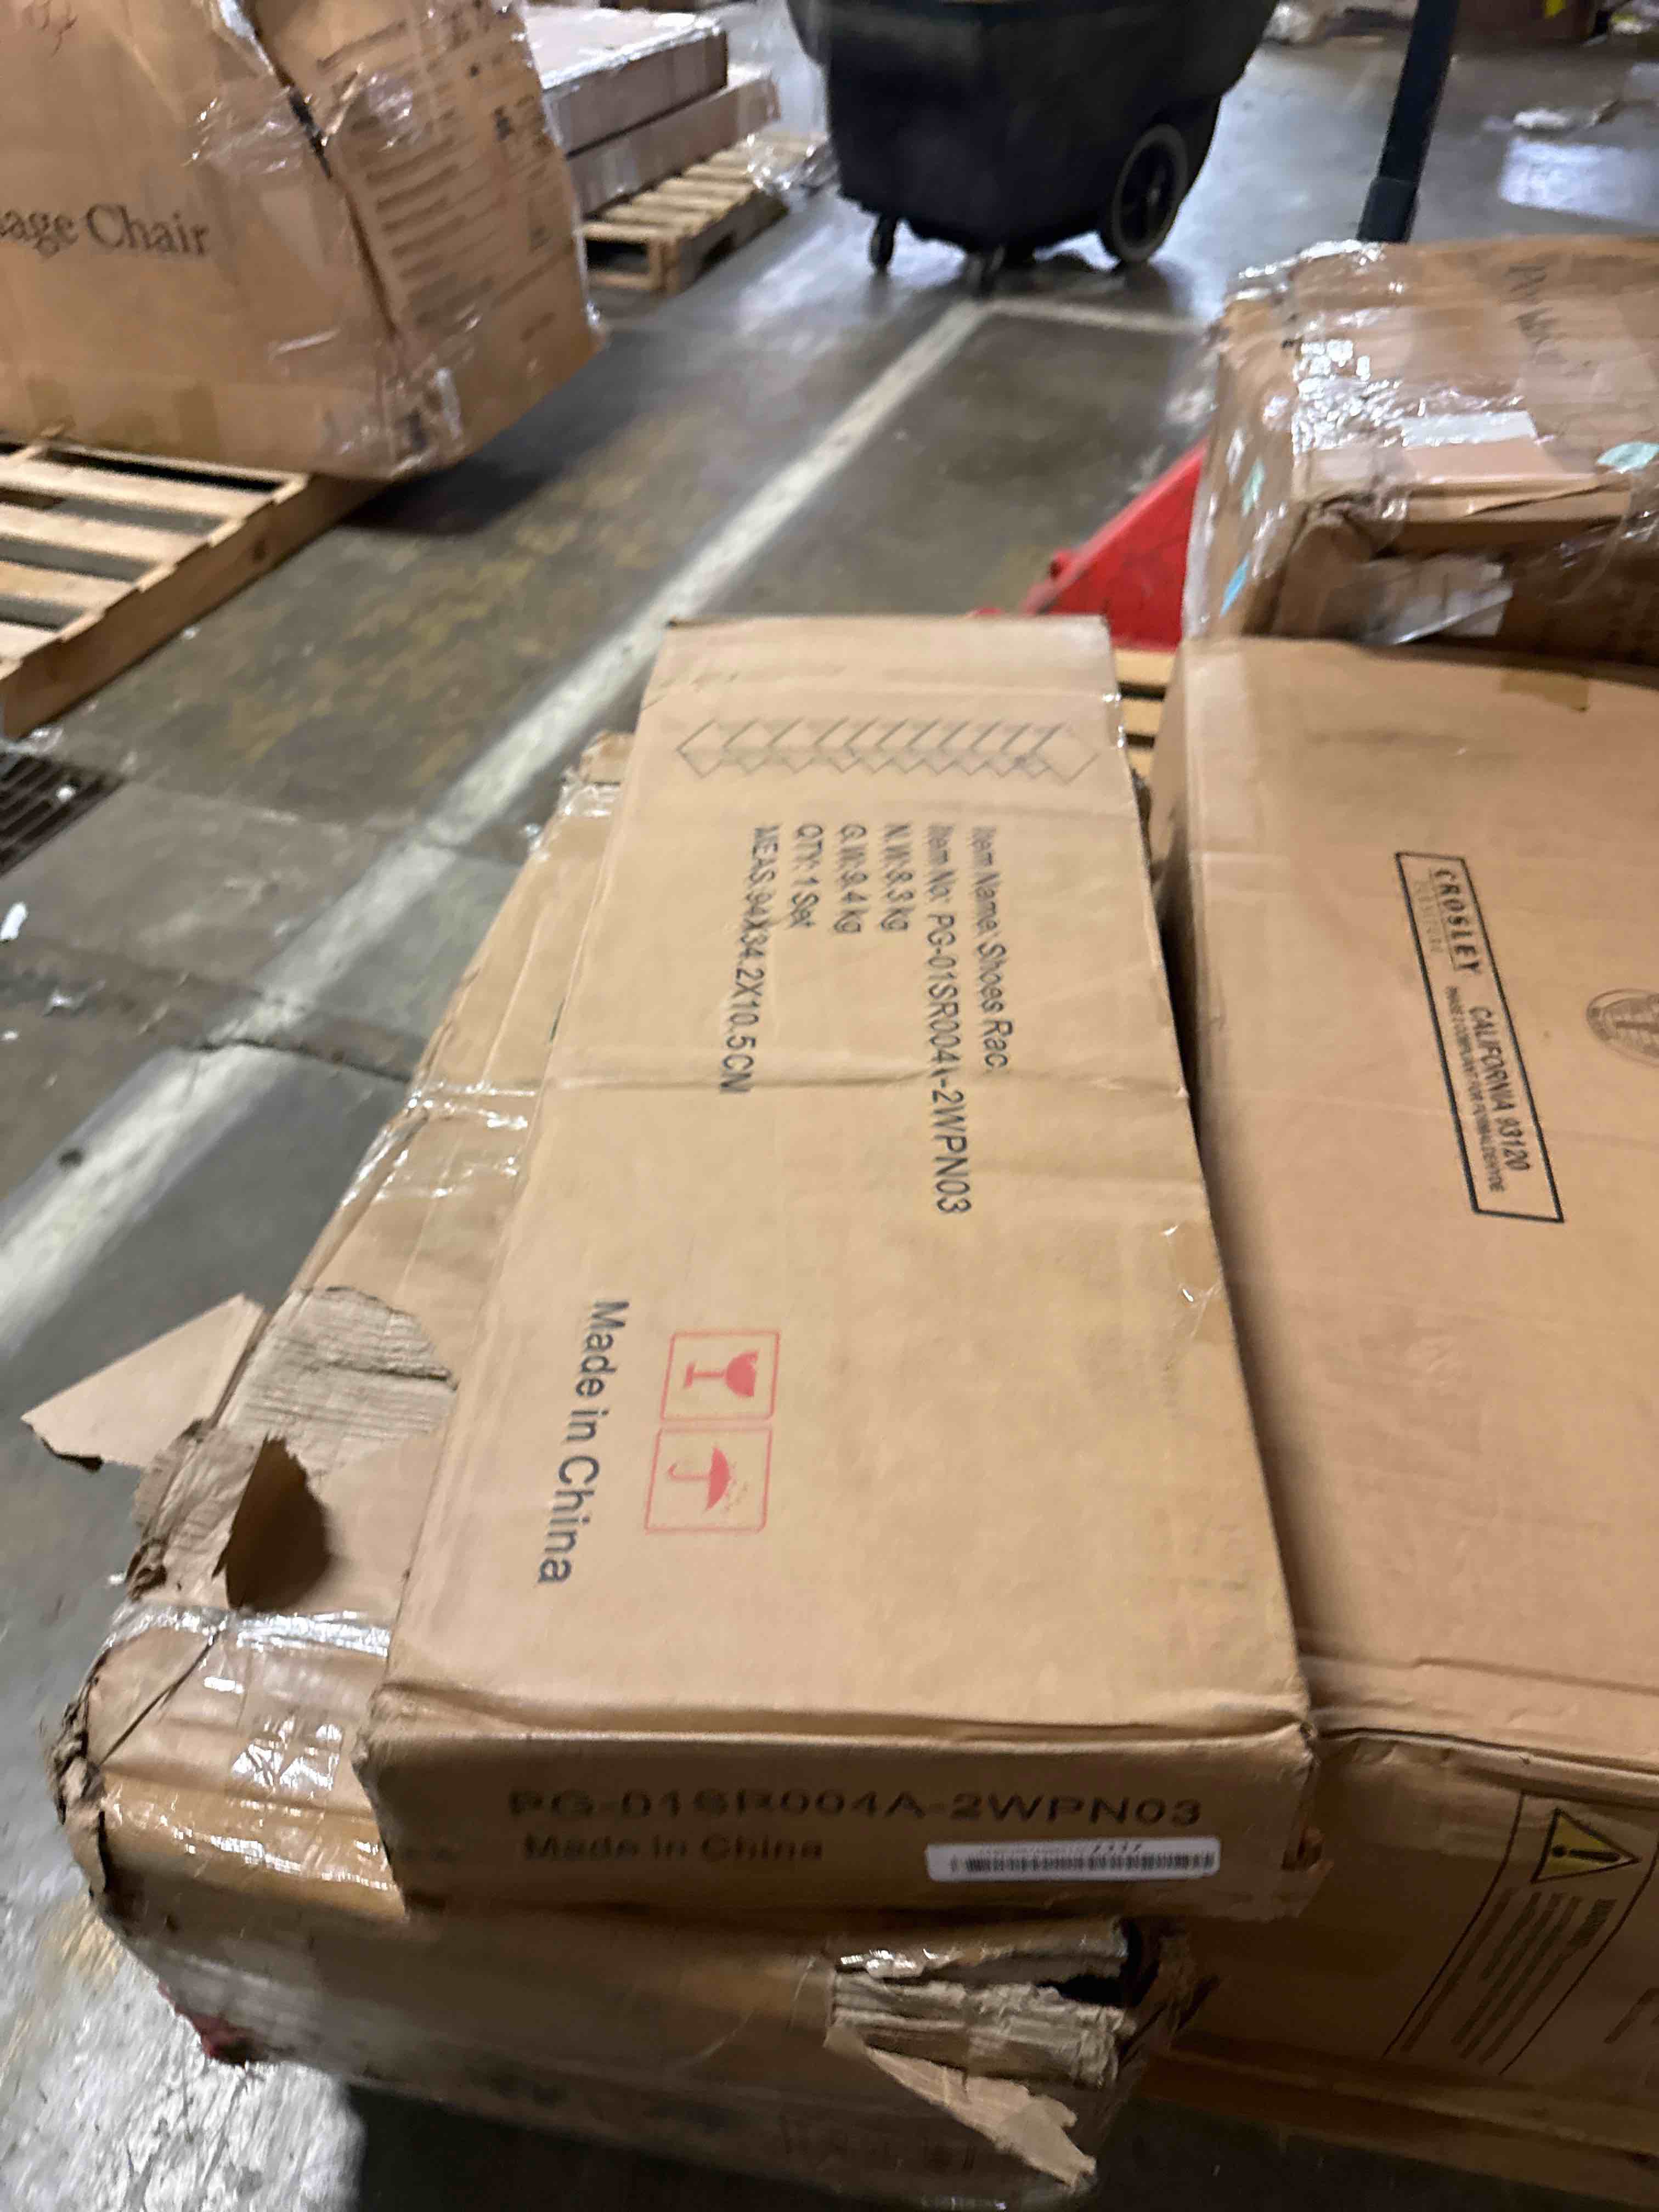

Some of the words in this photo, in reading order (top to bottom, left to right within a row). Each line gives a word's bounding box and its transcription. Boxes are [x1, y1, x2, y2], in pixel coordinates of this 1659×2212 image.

[0, 210, 78, 260] age
[86, 203, 208, 256] Chair
[977, 941, 1008, 1014] Shoes
[983, 1019, 1013, 1071] Rac
[575, 1300, 629, 1398] Made
[565, 1408, 609, 1444] in
[537, 1455, 600, 1585] China
[509, 1788, 1202, 1826] PG-01SR004A-2WPN03
[523, 1832, 640, 1861] Made
[652, 1833, 688, 1860] in
[701, 1833, 823, 1862] China
